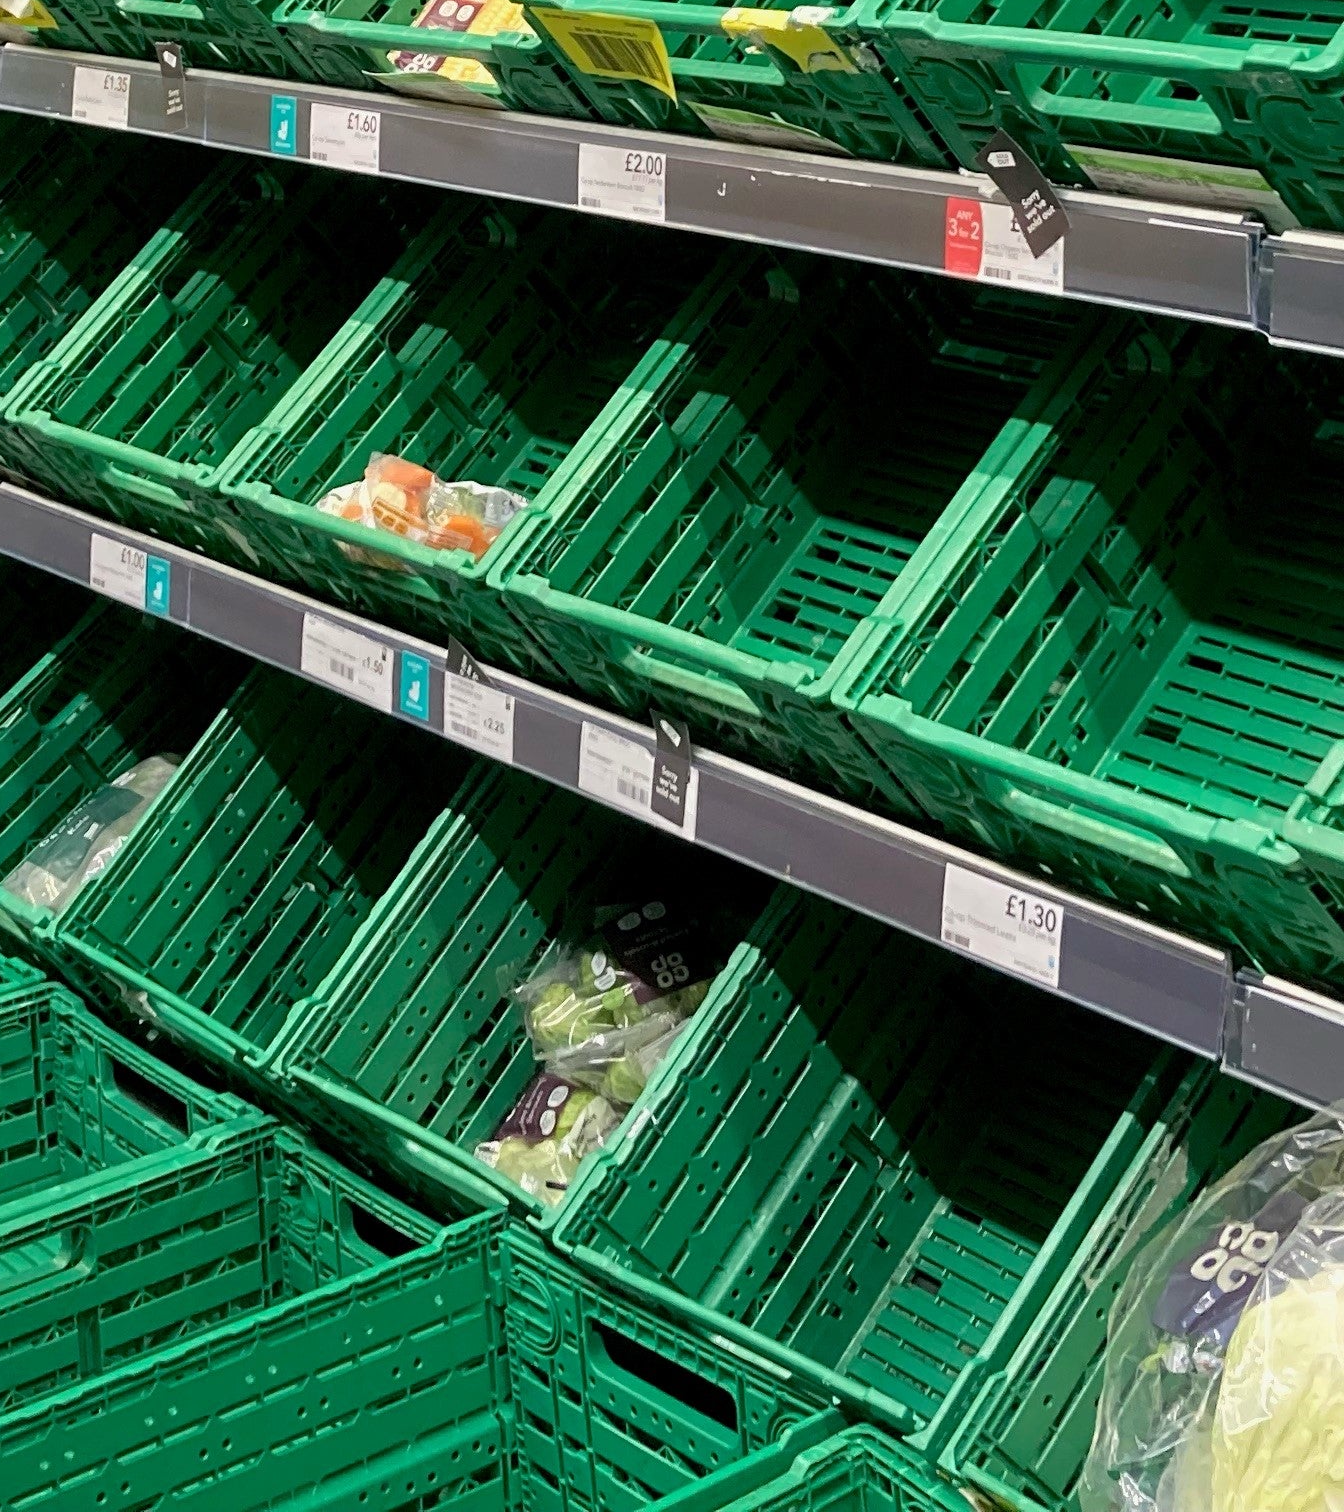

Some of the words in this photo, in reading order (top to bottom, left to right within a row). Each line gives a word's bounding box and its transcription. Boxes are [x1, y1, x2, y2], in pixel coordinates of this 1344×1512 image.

[347, 111, 377, 134] £1.60
[624, 152, 663, 176] £2.00
[956, 209, 974, 221] ANY
[947, 218, 958, 238] 3
[970, 221, 980, 241] 2
[362, 656, 384, 676] £1.50
[1006, 894, 1057, 932] £1.30
